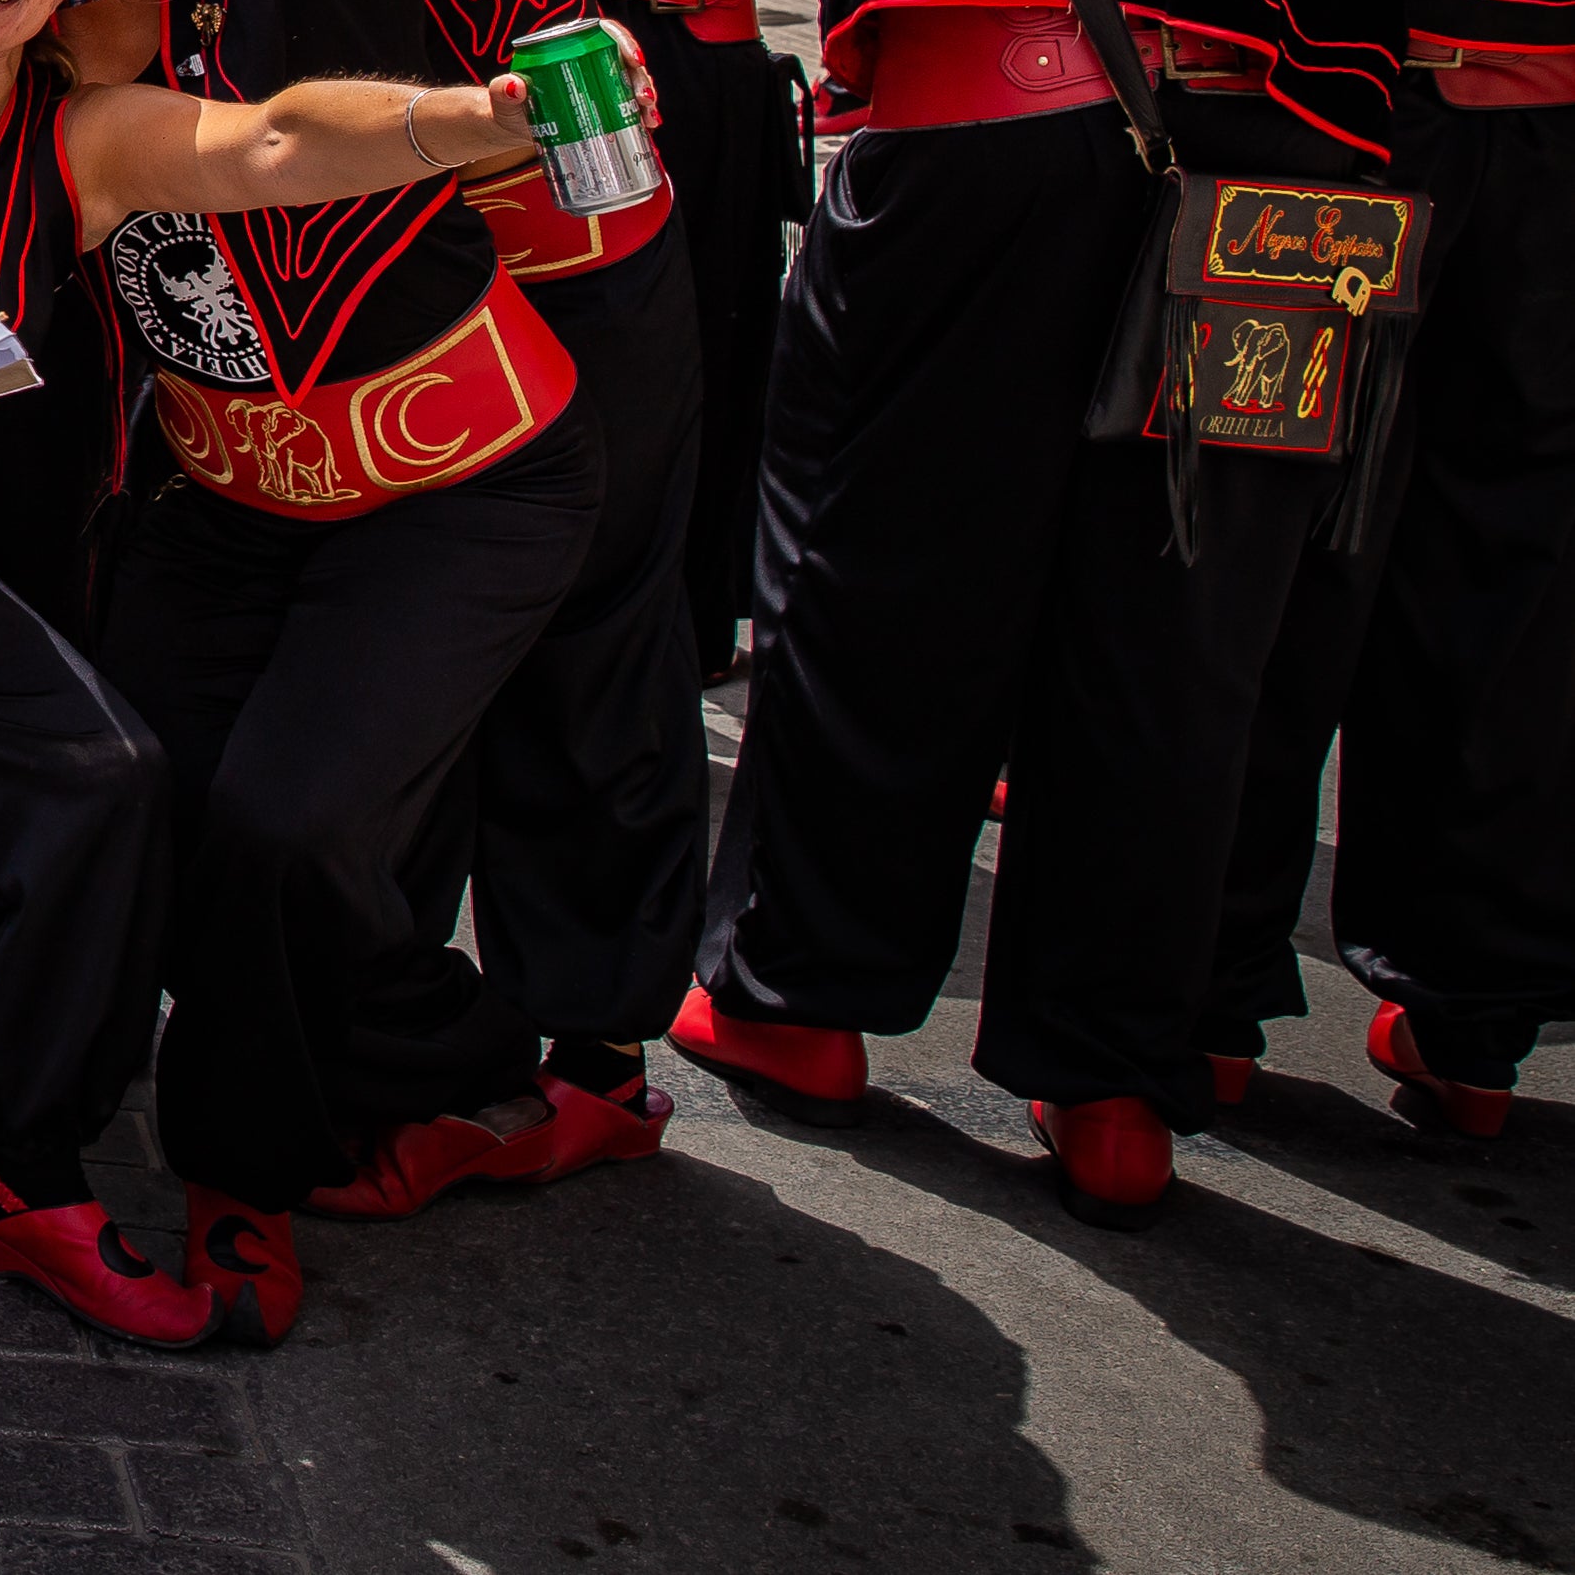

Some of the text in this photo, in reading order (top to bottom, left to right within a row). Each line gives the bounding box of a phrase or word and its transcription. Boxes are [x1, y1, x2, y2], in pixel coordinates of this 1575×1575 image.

[115, 212, 214, 330] MOROS Y CRI
[1199, 415, 1285, 439] ORIHUELA
